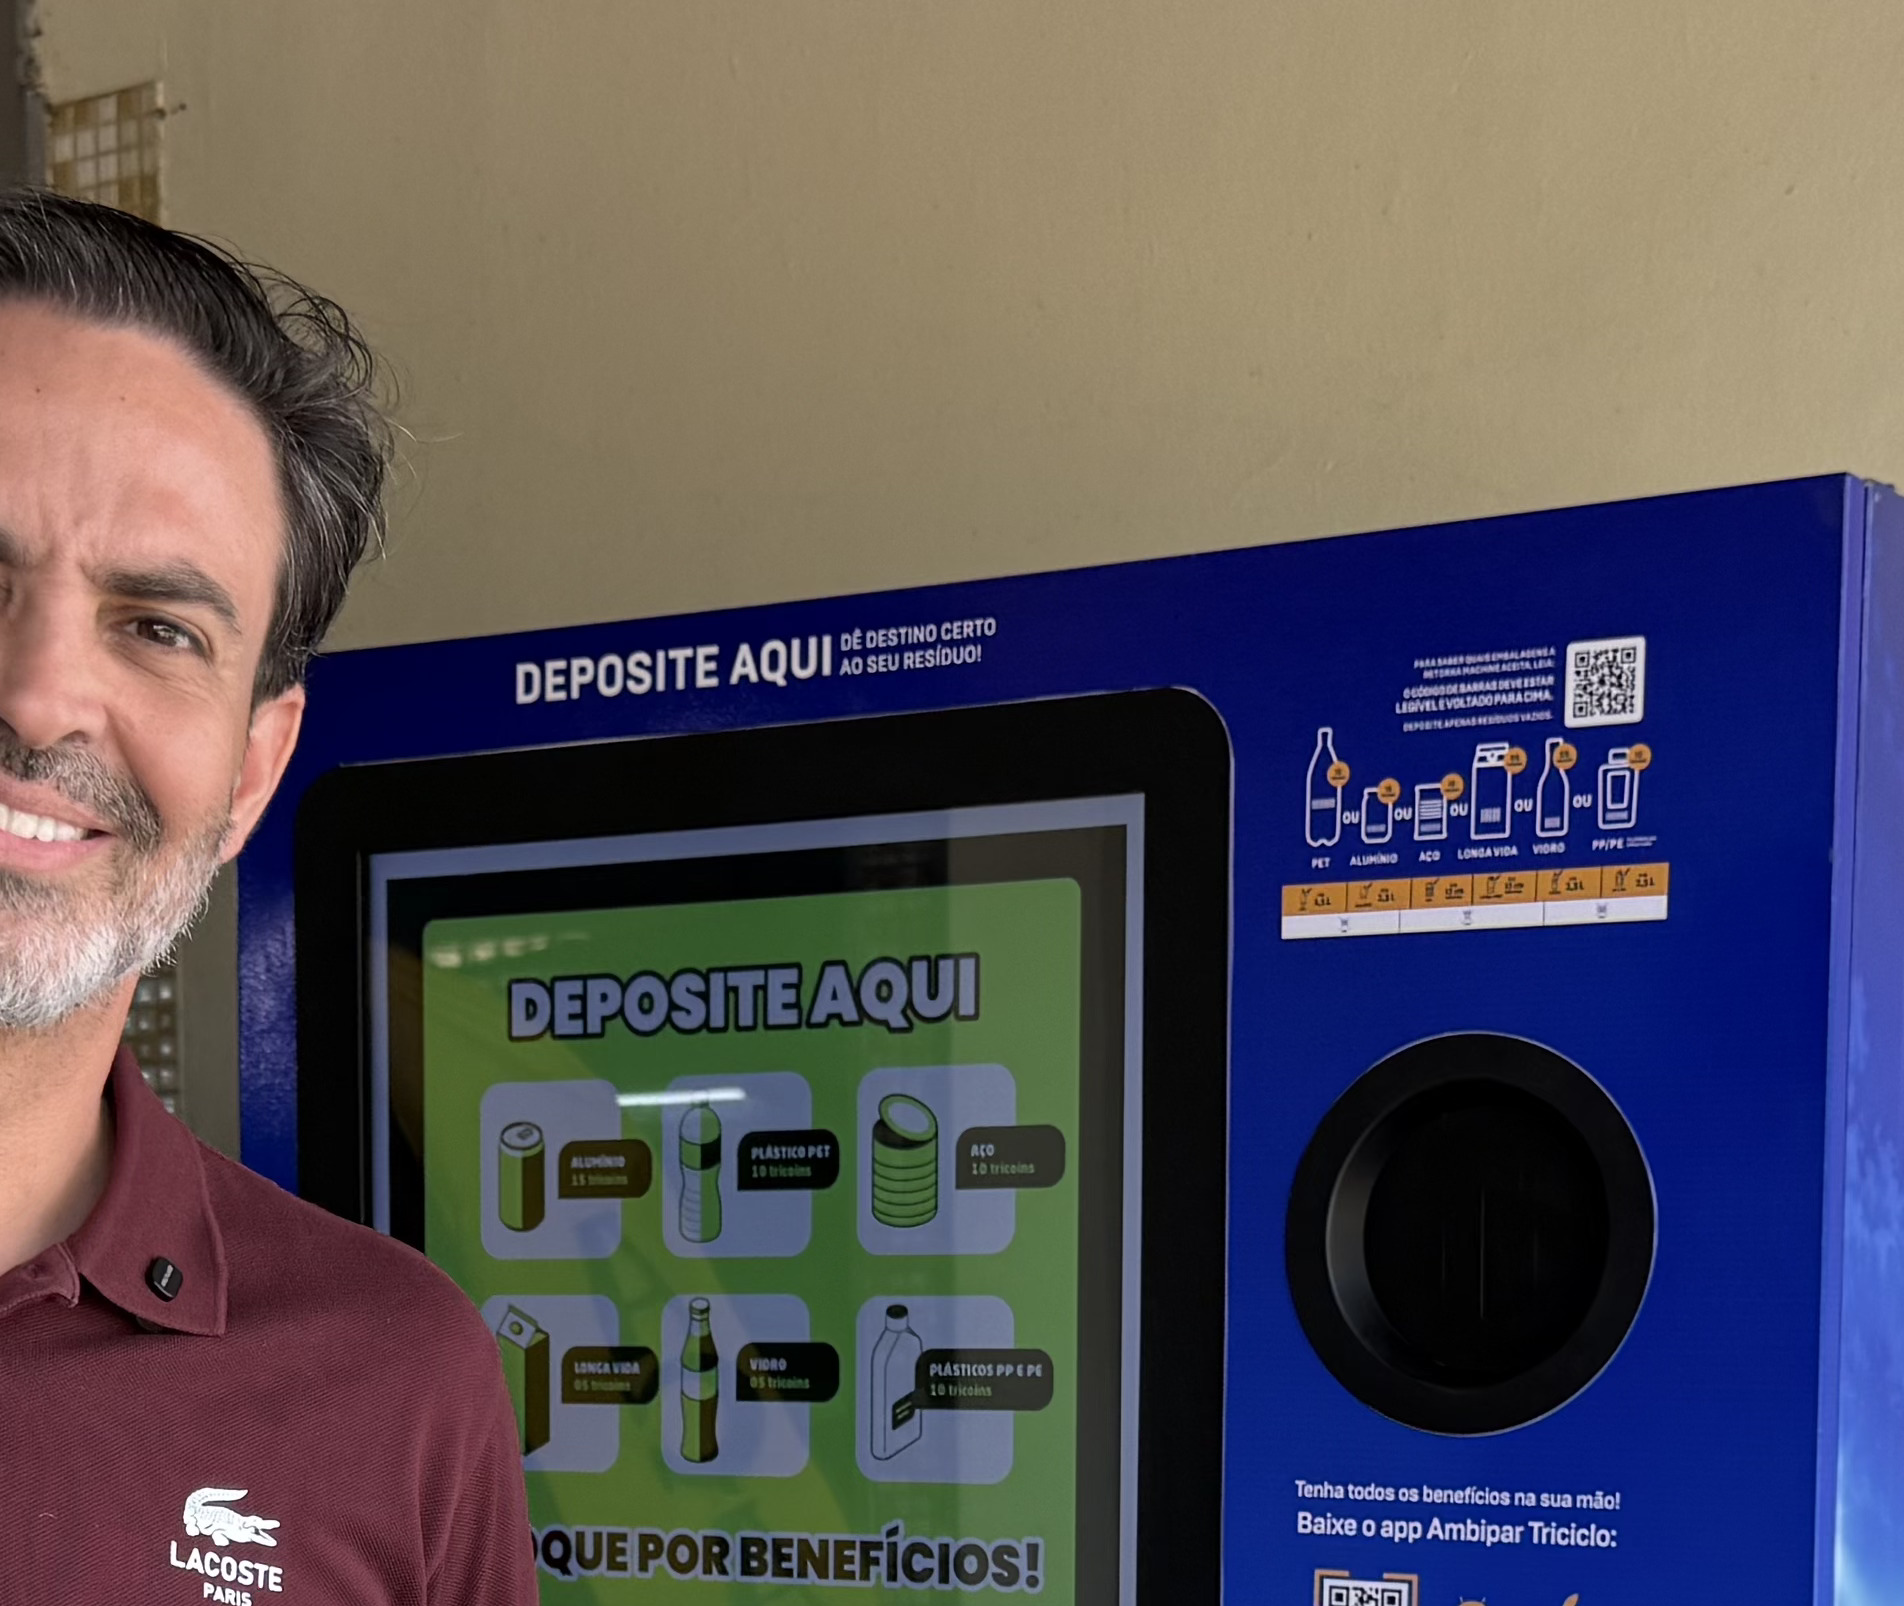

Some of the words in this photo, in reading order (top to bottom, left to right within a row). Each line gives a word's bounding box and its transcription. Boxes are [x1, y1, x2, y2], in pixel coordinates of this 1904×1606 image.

[840, 629, 863, 652] DÊ
[866, 624, 937, 649] DESTINO
[941, 617, 996, 641] CERTO
[840, 656, 862, 676] AO
[866, 652, 898, 674] SEU
[903, 643, 982, 670] RESÍDUO!
[515, 645, 719, 704] DEPOSITE
[730, 635, 832, 687] AQUI
[1458, 680, 1497, 694] BARRAS
[1523, 676, 1555, 688] ESTAR
[1395, 698, 1438, 714] LEGÍVEL
[1445, 694, 1493, 711] VOLTADO
[1494, 692, 1522, 705] PARA
[1342, 811, 1360, 824] OU
[1394, 807, 1412, 820] OU
[1450, 803, 1468, 816] OU
[1514, 799, 1533, 812] OU
[1572, 794, 1592, 808] OU
[1533, 842, 1565, 855] VIDRO
[1592, 837, 1624, 851] PP/PE
[1350, 853, 1398, 866] ALUMÍNIO
[1418, 850, 1441, 862] AÇO
[1457, 846, 1492, 860] LONGA
[1493, 845, 1519, 858] VIDA
[1312, 857, 1330, 869] PET
[508, 964, 800, 1041] DEPOSITE
[806, 953, 980, 1034] AQUI
[750, 1144, 806, 1161] PLÁSTICO
[807, 1143, 831, 1159] PET
[970, 1143, 995, 1158] AÇO
[570, 1153, 626, 1169] ALUMÍNIO
[972, 1162, 988, 1175] 10
[990, 1161, 1035, 1175] tricoins
[751, 1165, 768, 1178] 10
[769, 1163, 813, 1178] tricoins
[574, 1361, 611, 1375] LONGA
[612, 1361, 641, 1375] VIDA
[749, 1357, 788, 1372] VIDRO
[929, 1361, 994, 1377] PLÁSTICOS
[996, 1363, 1014, 1377] PP
[1016, 1363, 1024, 1377] E
[1026, 1364, 1043, 1377] PE
[573, 1378, 589, 1392] 05
[749, 1376, 766, 1389] 05
[767, 1376, 811, 1390] tricoins
[929, 1382, 946, 1397] 10
[948, 1382, 993, 1397] tricoins
[1296, 1480, 1344, 1500] Tenha
[1348, 1483, 1395, 1501] todos
[1399, 1488, 1419, 1502] os
[1422, 1485, 1510, 1506] benefícios
[1515, 1492, 1536, 1507] na
[1540, 1493, 1572, 1508] sua
[1576, 1491, 1620, 1510] mão!
[1297, 1511, 1357, 1537] Baixe
[1361, 1518, 1376, 1536] o
[1380, 1520, 1422, 1543] app
[1427, 1517, 1524, 1547] Ambipar
[1528, 1520, 1617, 1548] Triciclo:
[638, 1532, 736, 1579] POR
[740, 1520, 1045, 1594] BENEFÍCIOS!
[170, 1540, 284, 1593] LACOSTE
